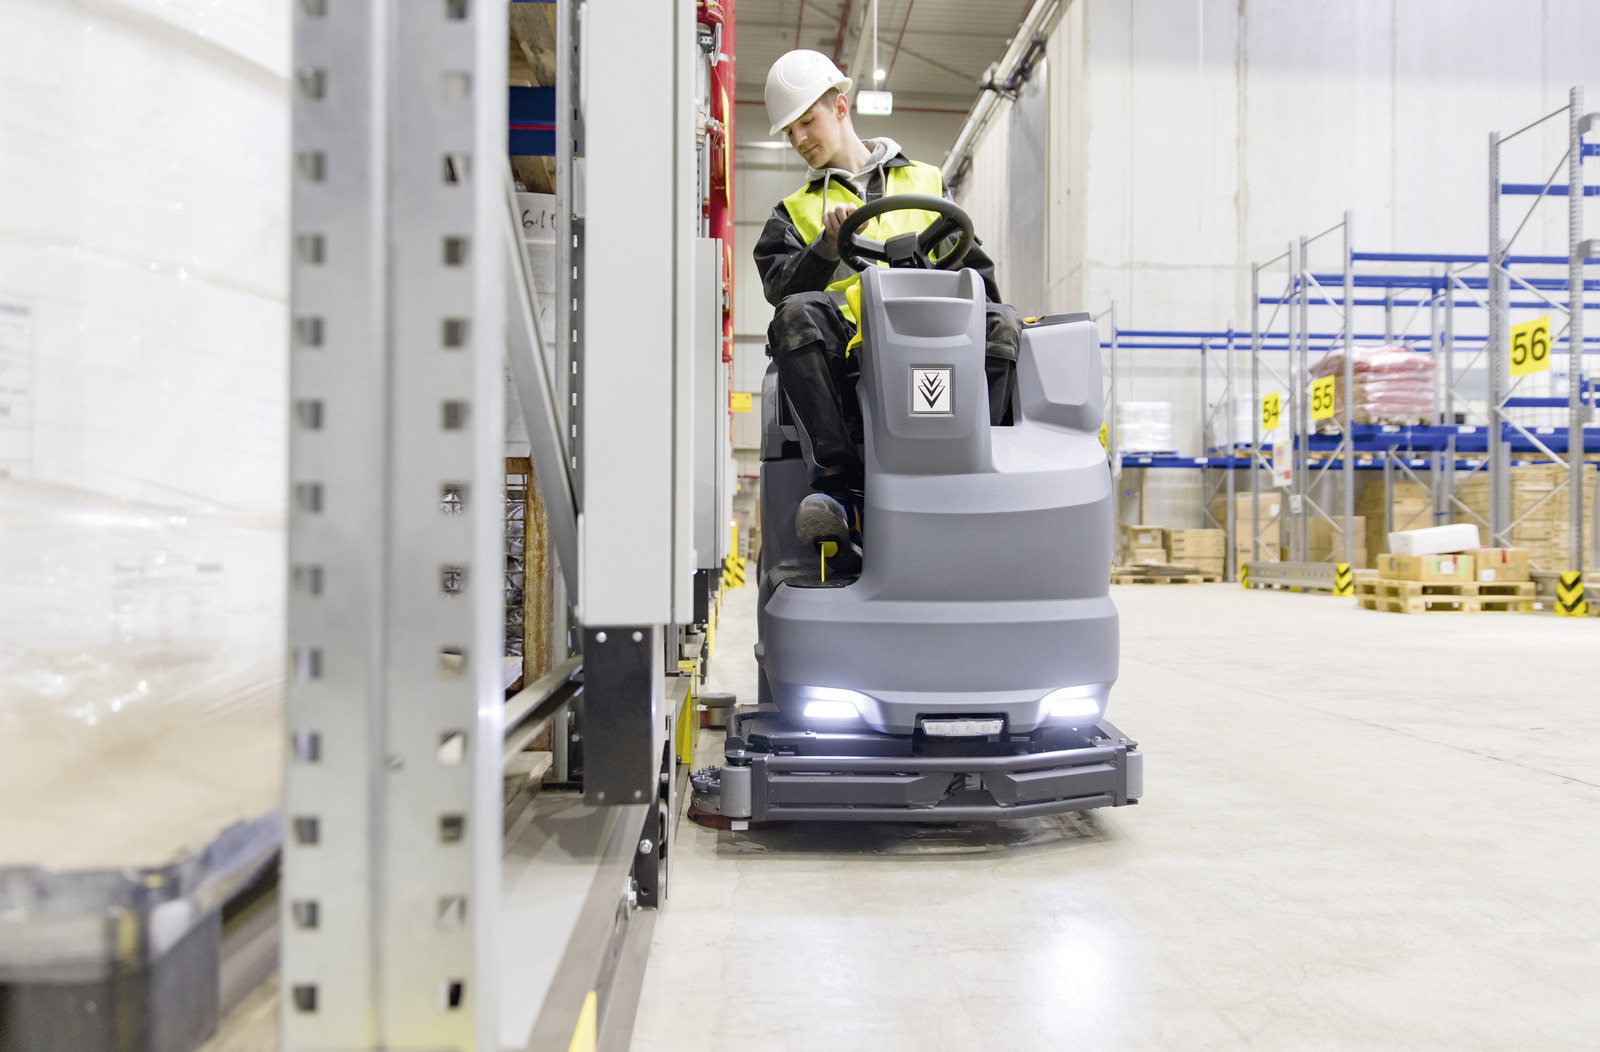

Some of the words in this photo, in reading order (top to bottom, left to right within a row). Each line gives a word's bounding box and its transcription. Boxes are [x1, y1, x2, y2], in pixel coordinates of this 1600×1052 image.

[1513, 326, 1547, 366] 56
[1263, 397, 1279, 423] 54
[1313, 384, 1333, 412] 55
